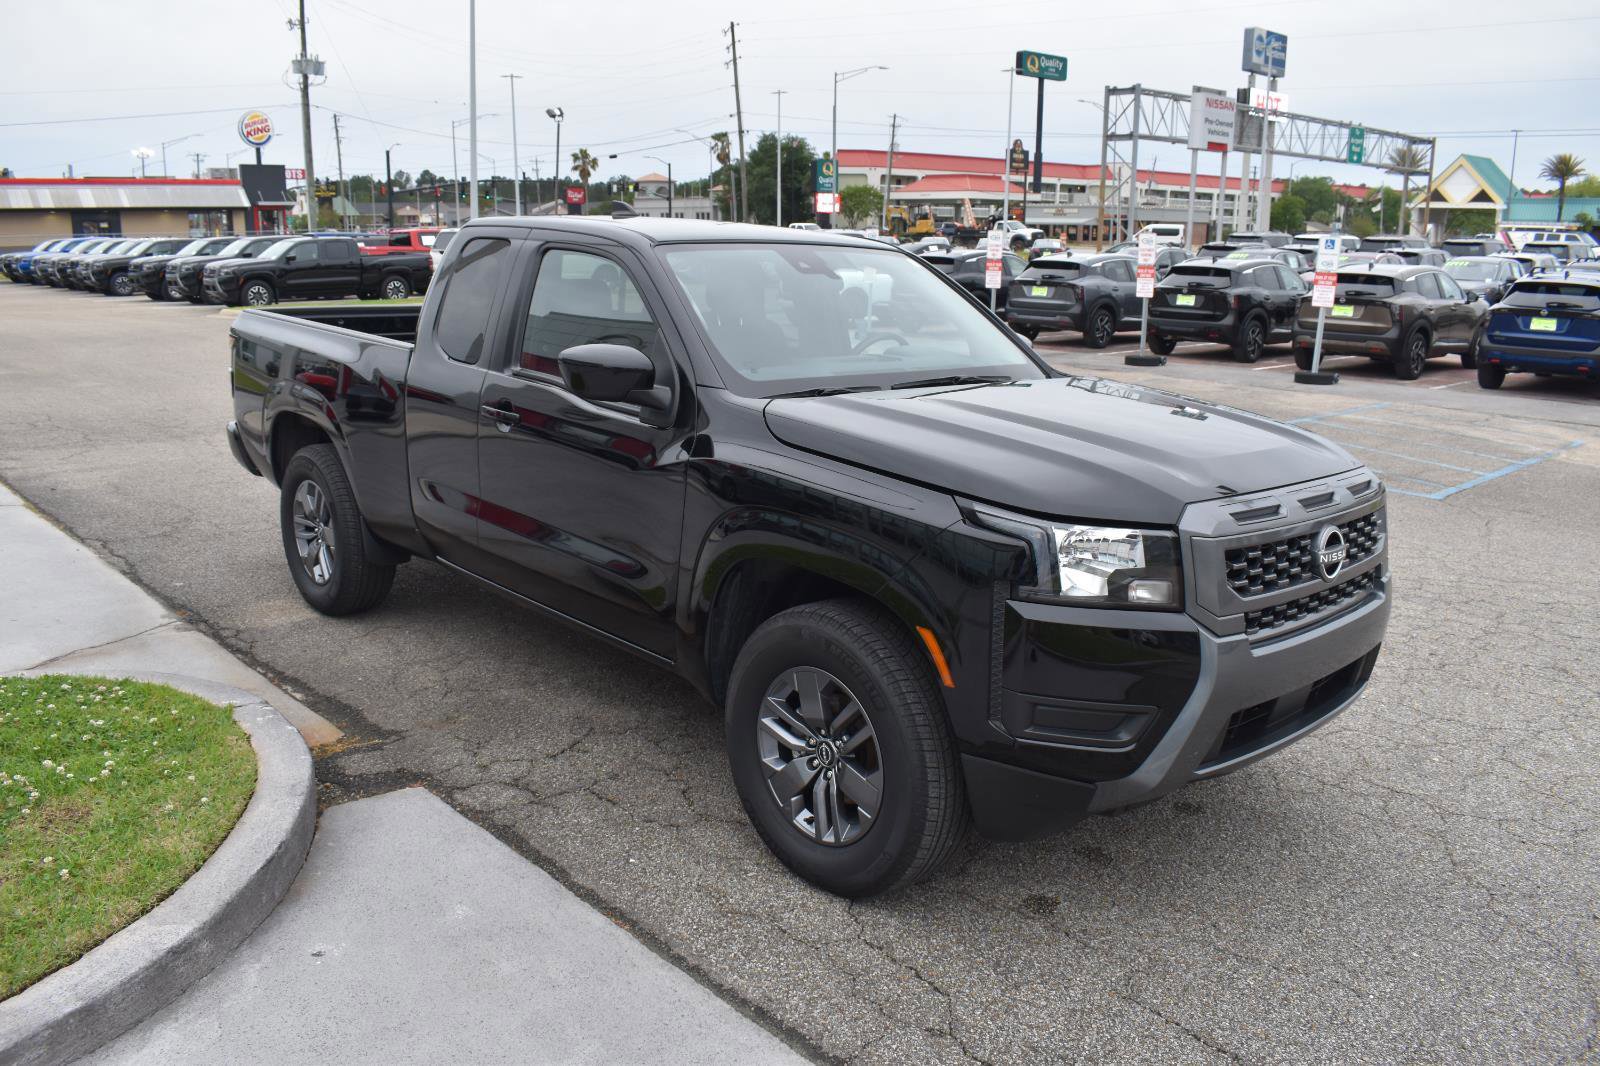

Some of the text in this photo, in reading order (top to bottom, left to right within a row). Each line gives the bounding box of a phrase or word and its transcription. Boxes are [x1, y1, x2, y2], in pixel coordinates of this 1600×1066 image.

[1040, 56, 1063, 71] Quality
[1205, 97, 1236, 112] NISSAN
[244, 118, 268, 129] BURGER
[246, 125, 271, 138] KING
